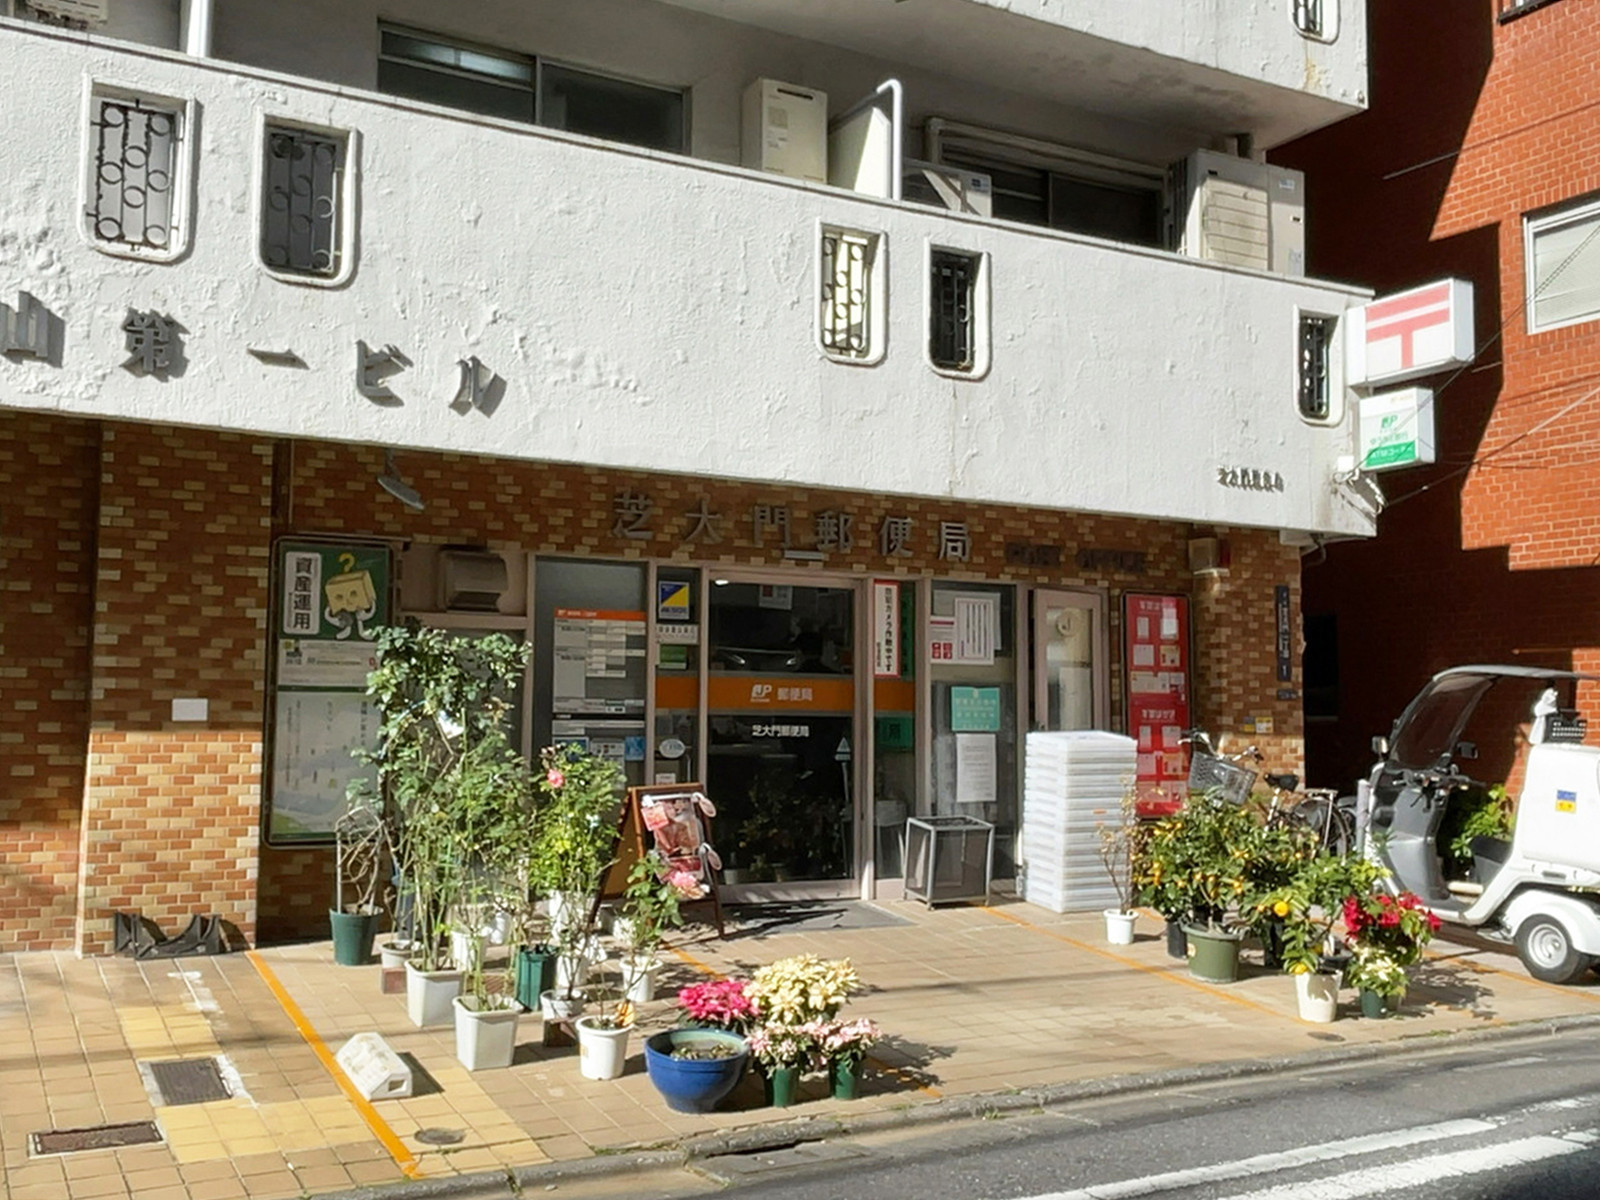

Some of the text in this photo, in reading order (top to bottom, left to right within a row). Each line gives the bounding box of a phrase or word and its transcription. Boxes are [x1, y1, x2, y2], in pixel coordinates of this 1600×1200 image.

[612, 490, 973, 563] 芝大門郵便局
[777, 687, 813, 702] 郵便局
